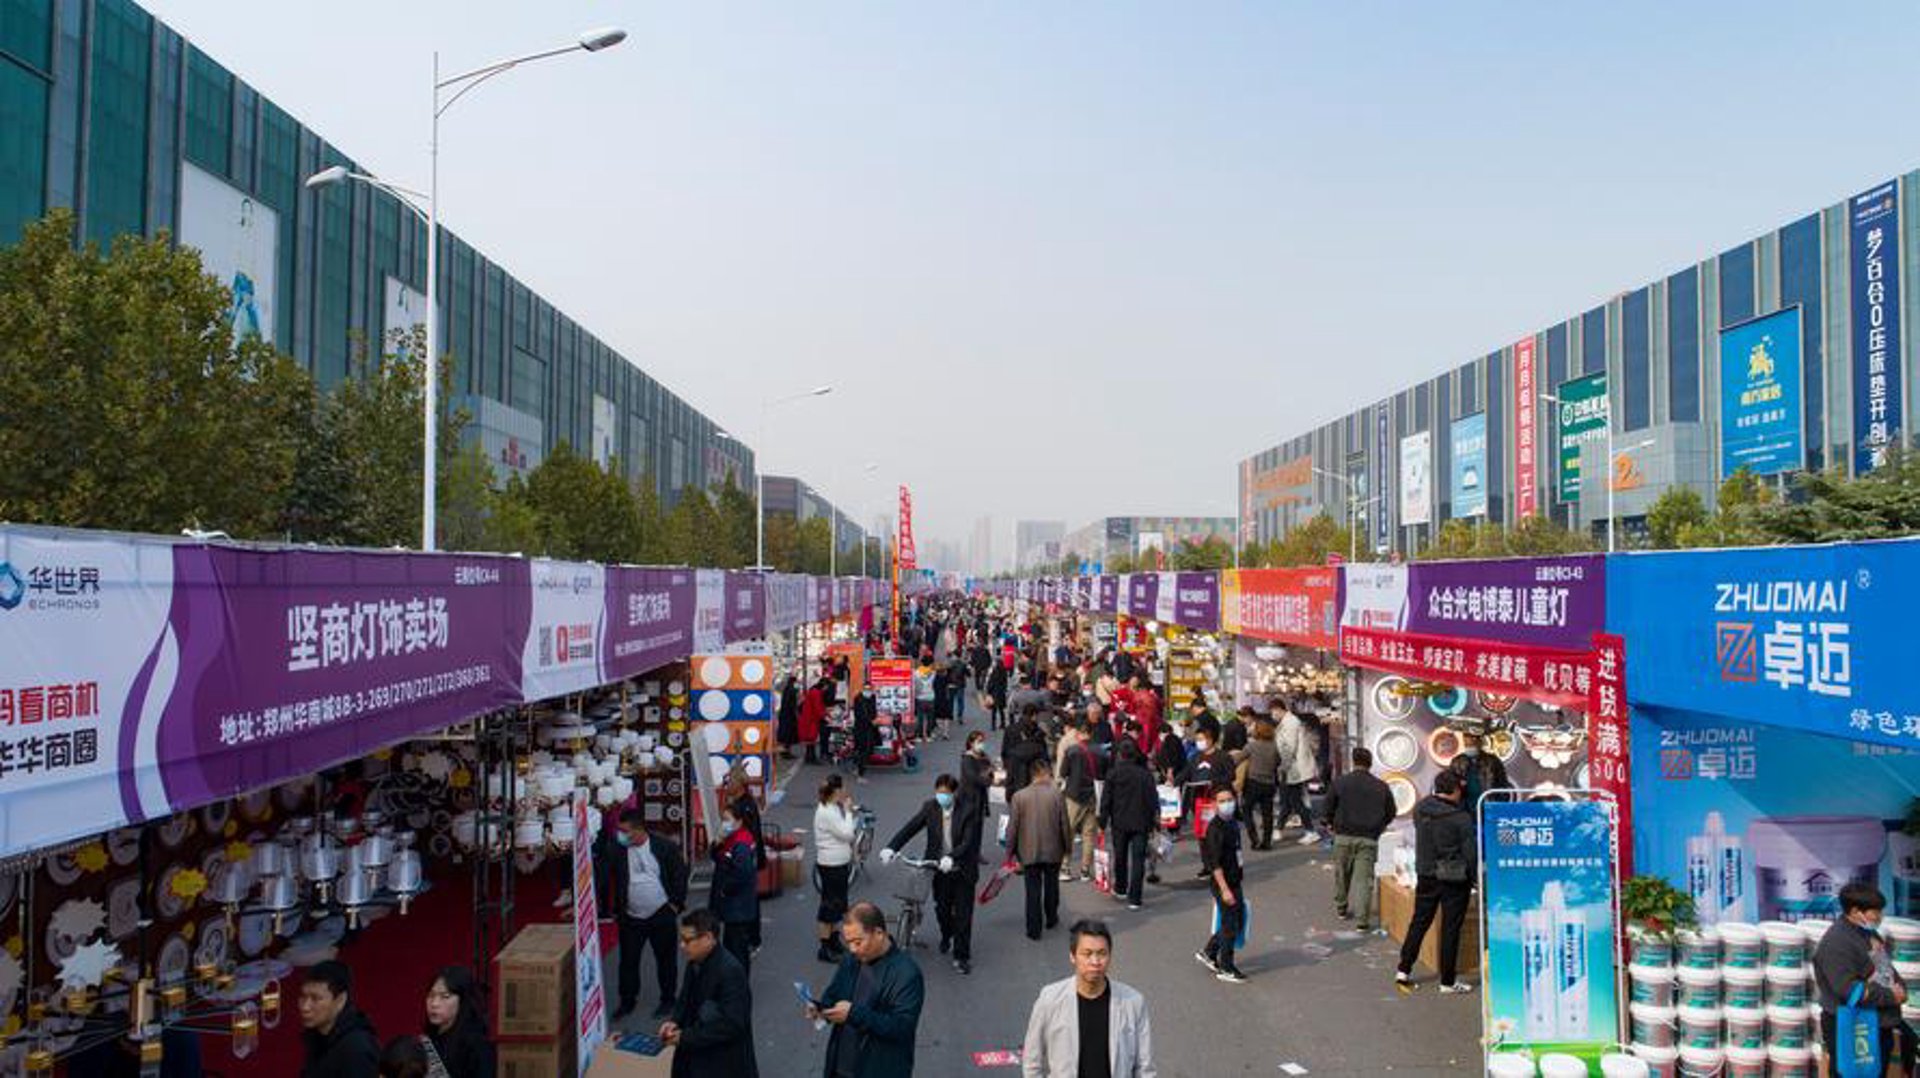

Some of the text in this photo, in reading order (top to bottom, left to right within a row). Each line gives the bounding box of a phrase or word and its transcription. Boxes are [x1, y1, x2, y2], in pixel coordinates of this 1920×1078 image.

[28, 566, 100, 595] 华世界
[1714, 580, 1847, 613] ZHUOMAI
[1428, 586, 1569, 627] 众合光电博泰儿童灯
[288, 597, 449, 671] 坚商灯饰卖场
[1764, 620, 1851, 697] 卓迈
[1661, 728, 1754, 746] ZHUOMAI
[1698, 746, 1756, 780] 卓迈
